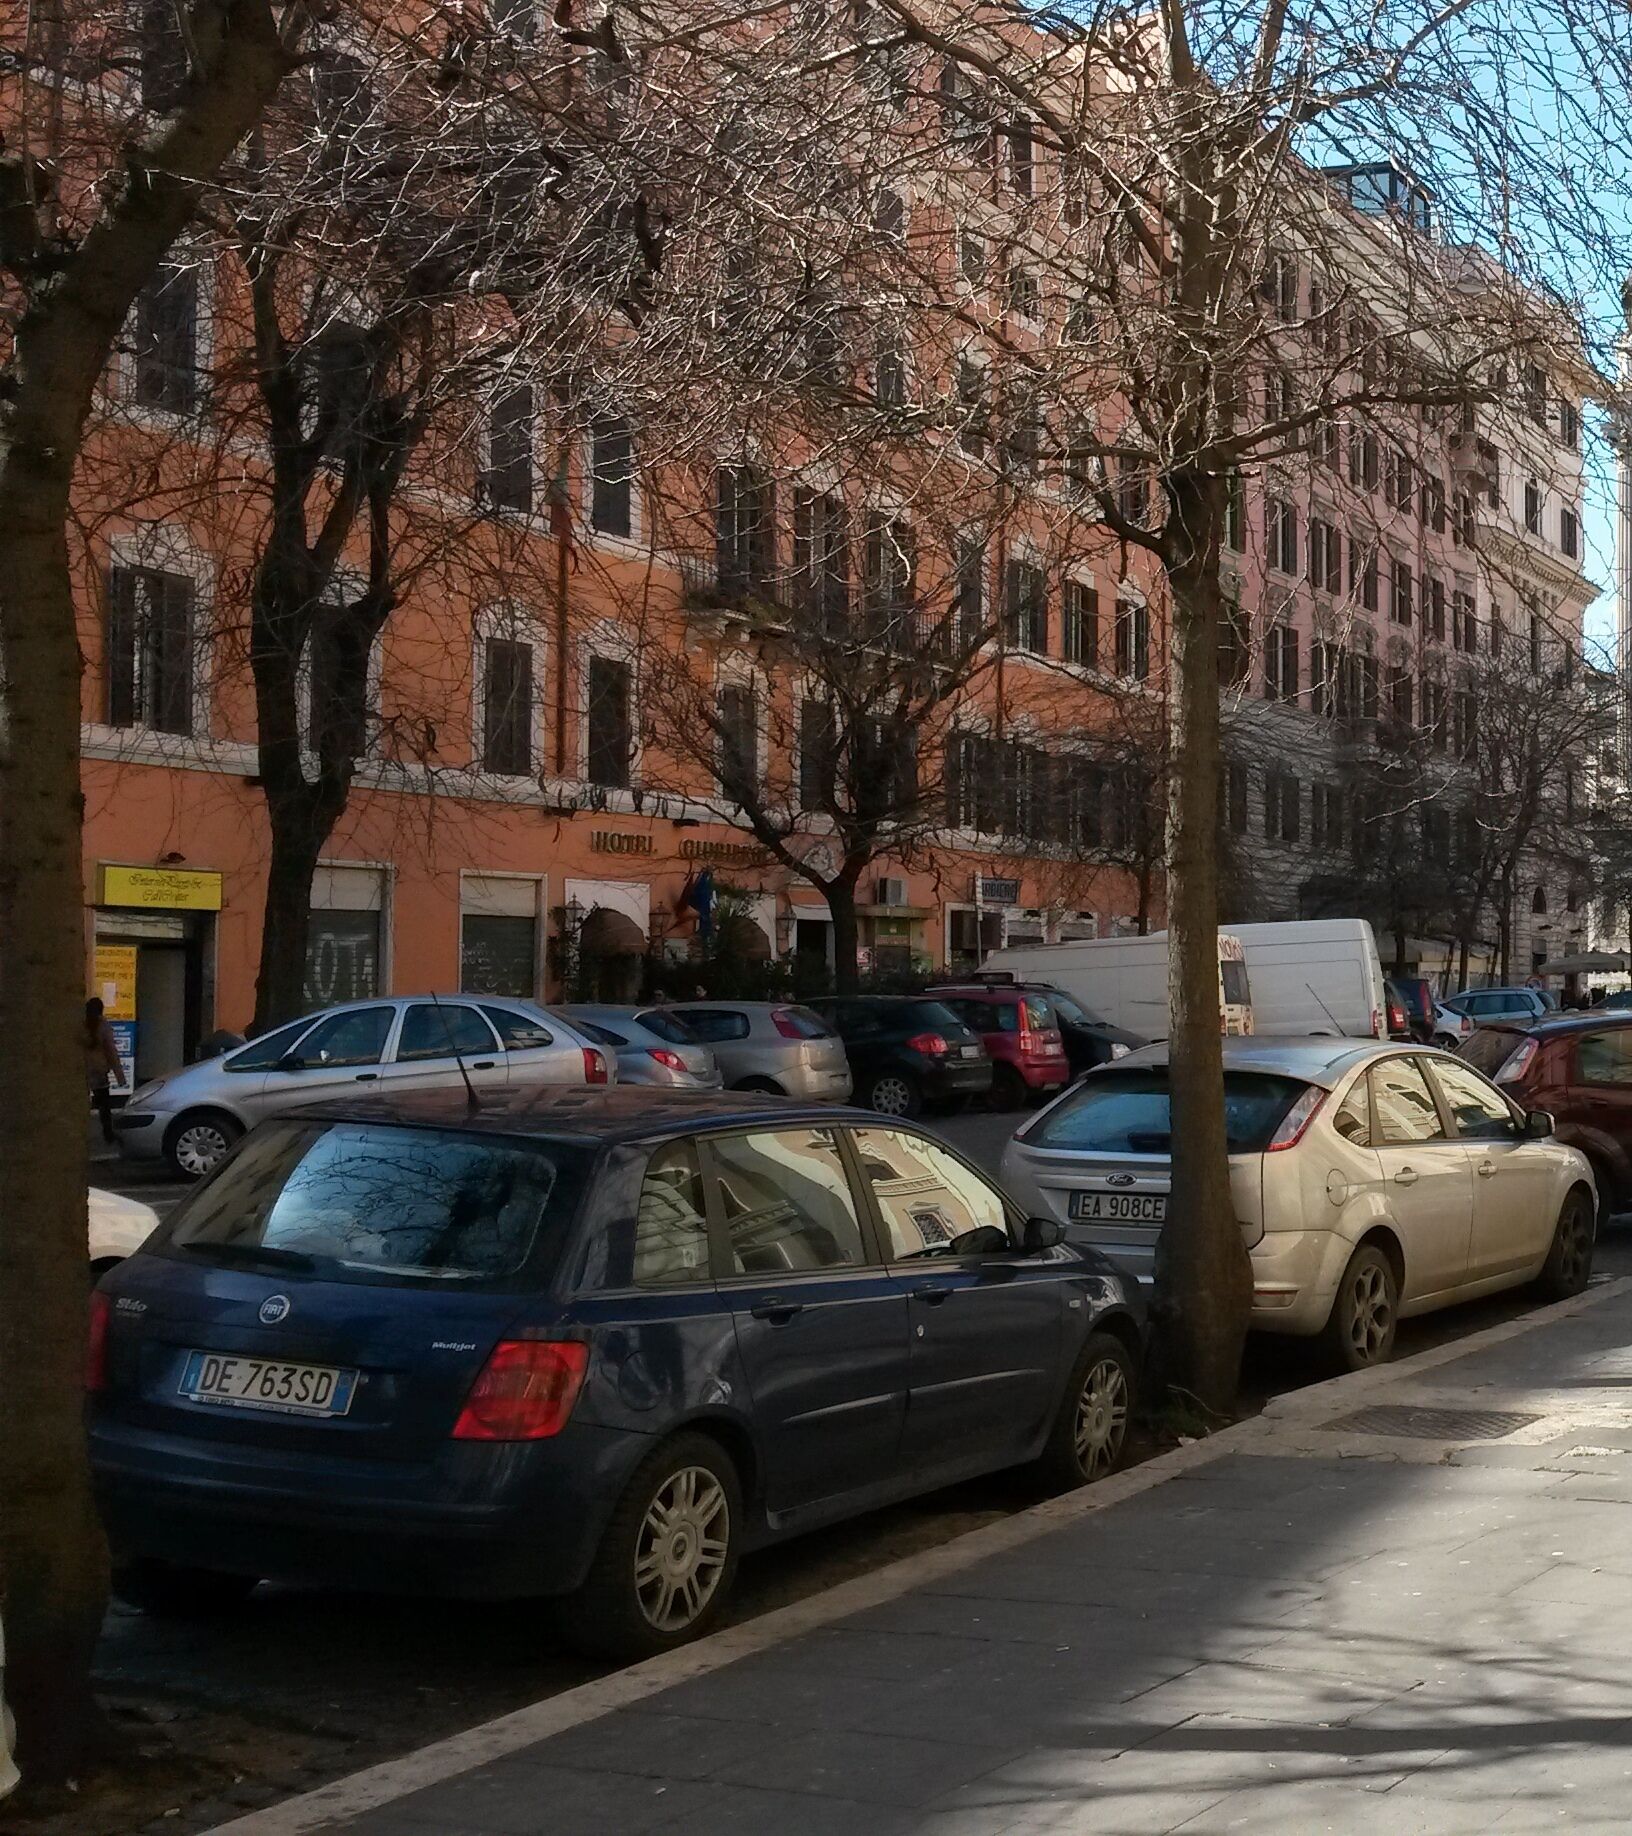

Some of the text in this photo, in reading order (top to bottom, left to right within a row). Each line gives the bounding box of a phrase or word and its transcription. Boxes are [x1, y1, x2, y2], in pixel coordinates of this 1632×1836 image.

[590, 830, 653, 857] HOTEL
[1081, 1195, 1101, 1216] EA
[1109, 1197, 1164, 1219] 908CE
[115, 1297, 148, 1312] Stilo
[262, 1303, 285, 1316] FIAT
[200, 1357, 238, 1393] DE
[241, 1362, 333, 1405] 763SD
